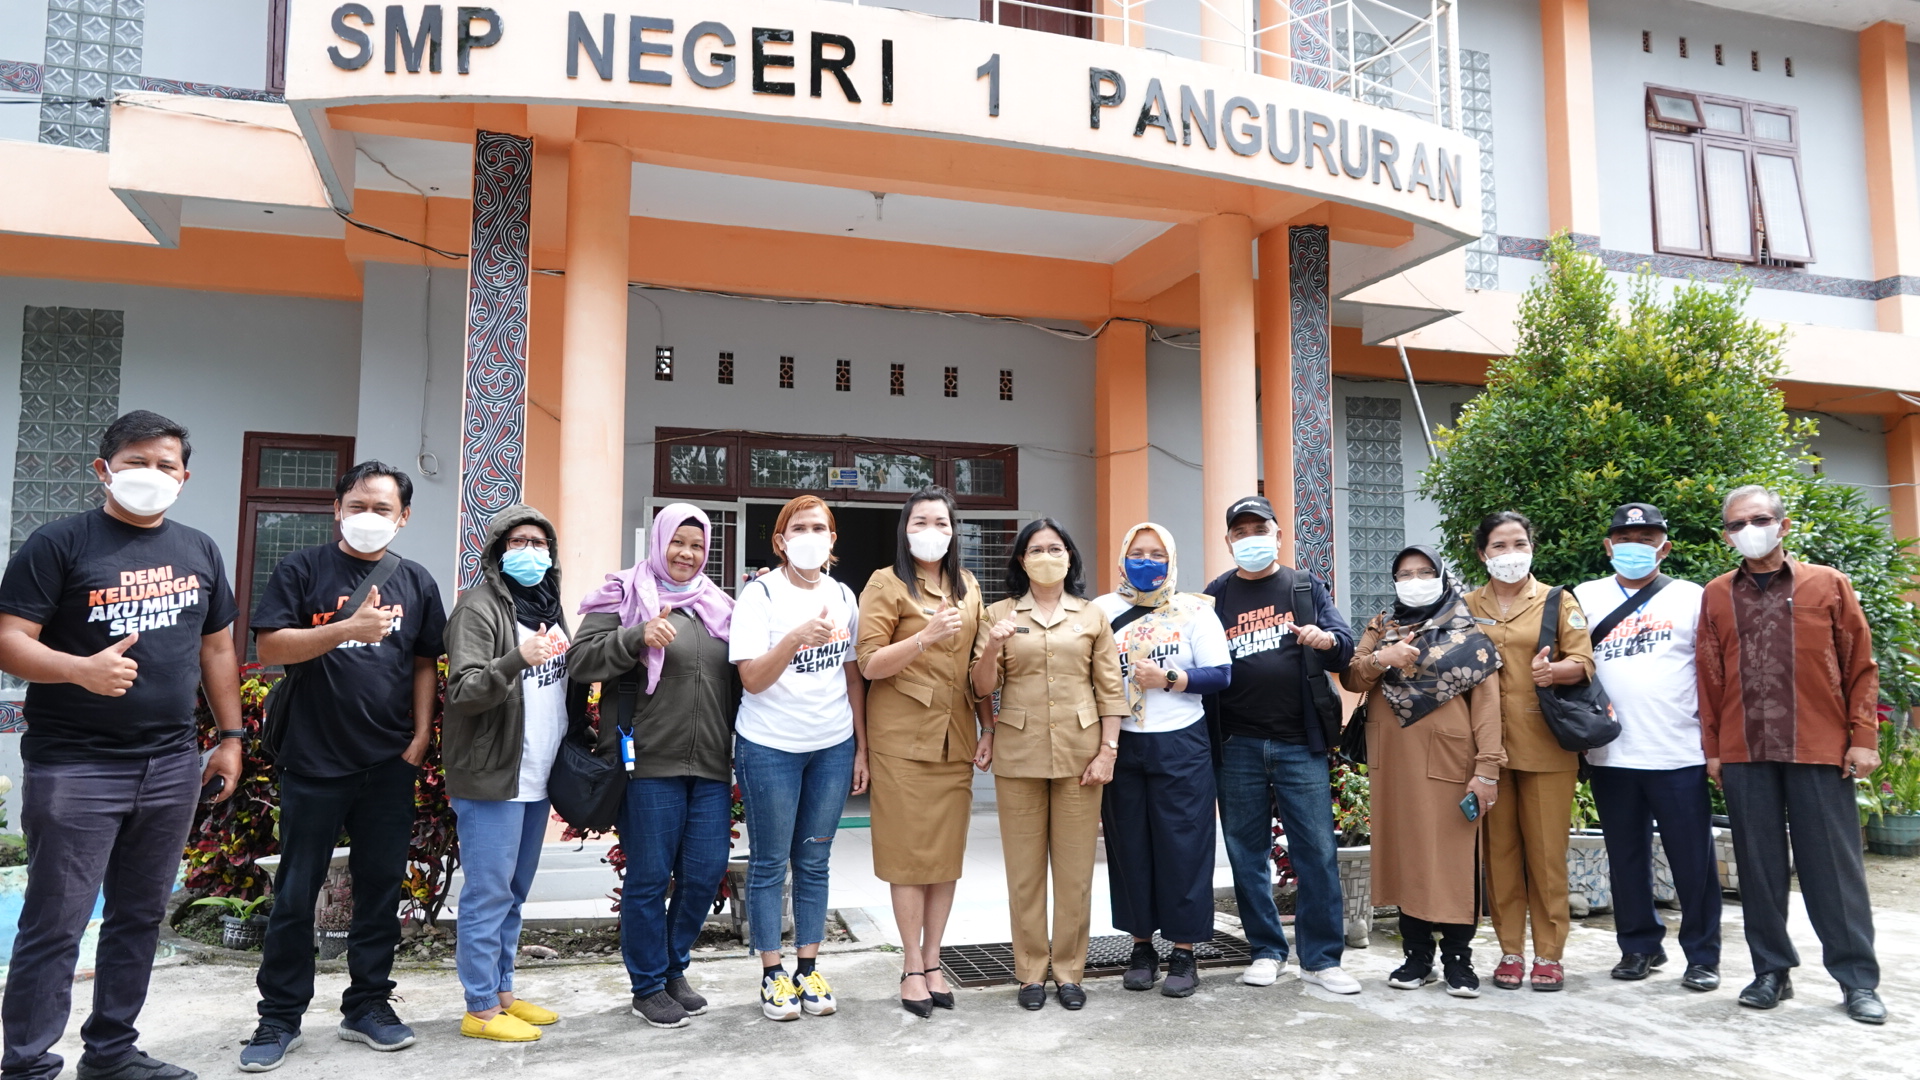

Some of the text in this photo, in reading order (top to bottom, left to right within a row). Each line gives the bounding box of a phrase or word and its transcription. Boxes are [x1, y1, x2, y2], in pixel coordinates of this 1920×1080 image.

[327, 3, 1463, 208] SMP NEGERI 1 PANGURURAN
[120, 565, 174, 587] DEMI
[88, 574, 200, 607] KELUARGA
[87, 589, 199, 623] AKU MILIH
[1237, 605, 1275, 625] DEMI
[109, 608, 182, 637] SEHAT
[789, 650, 814, 665] KU
[1235, 636, 1282, 659] SEHAT
[796, 654, 841, 673] SEHAT
